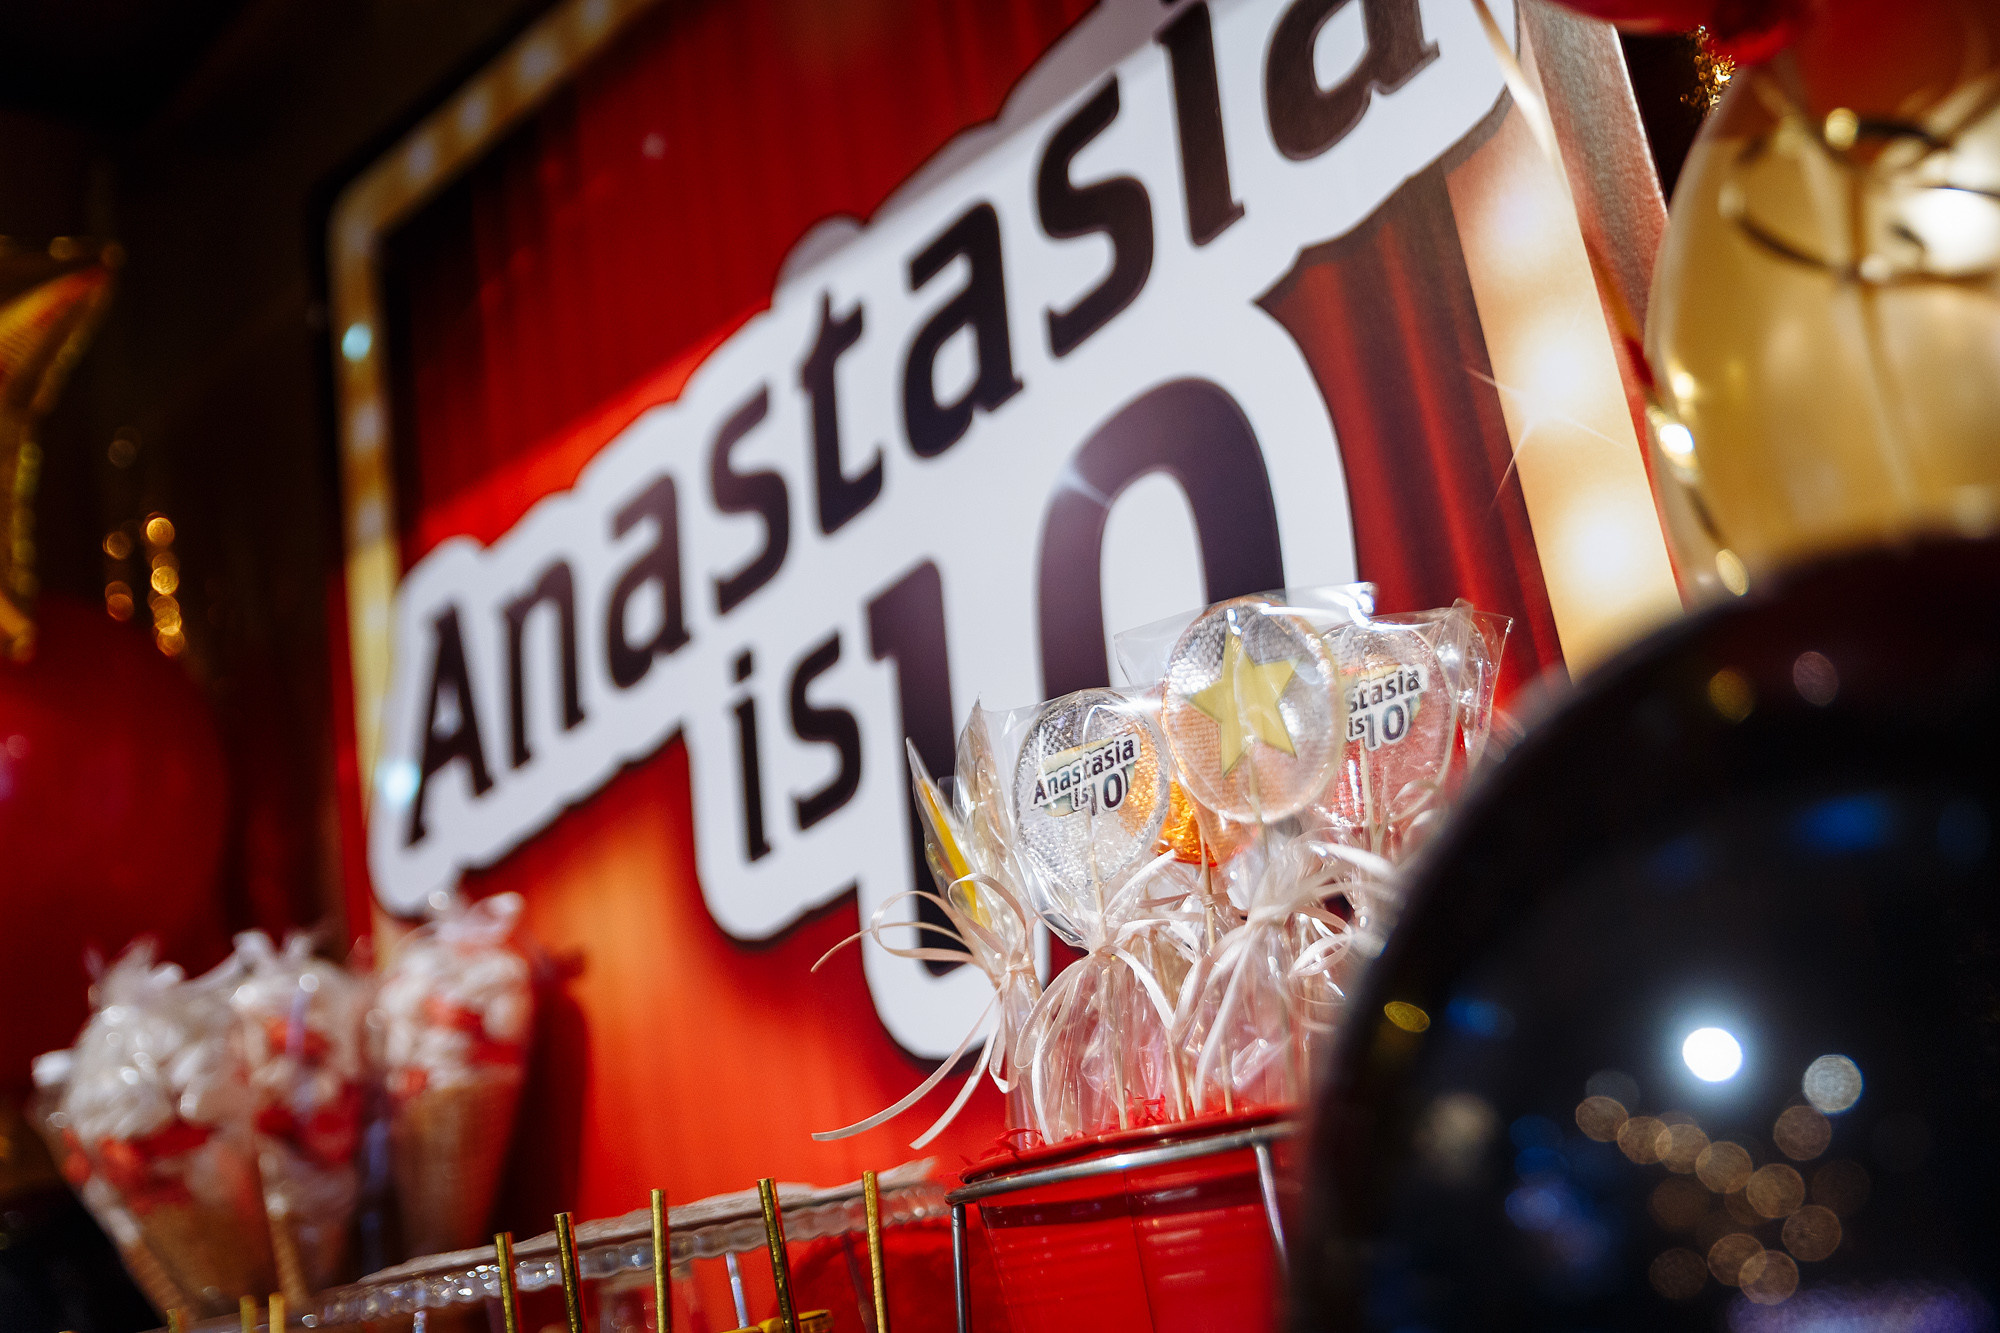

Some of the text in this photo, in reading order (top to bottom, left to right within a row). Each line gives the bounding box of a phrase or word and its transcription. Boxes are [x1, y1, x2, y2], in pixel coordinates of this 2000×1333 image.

[407, 0, 1440, 845] Anastasia
[731, 375, 1287, 978] is 10
[1346, 670, 1419, 713] stasia
[1348, 704, 1405, 748] is 10
[1033, 739, 1135, 805] Anastasia
[1073, 772, 1122, 816] is 10
